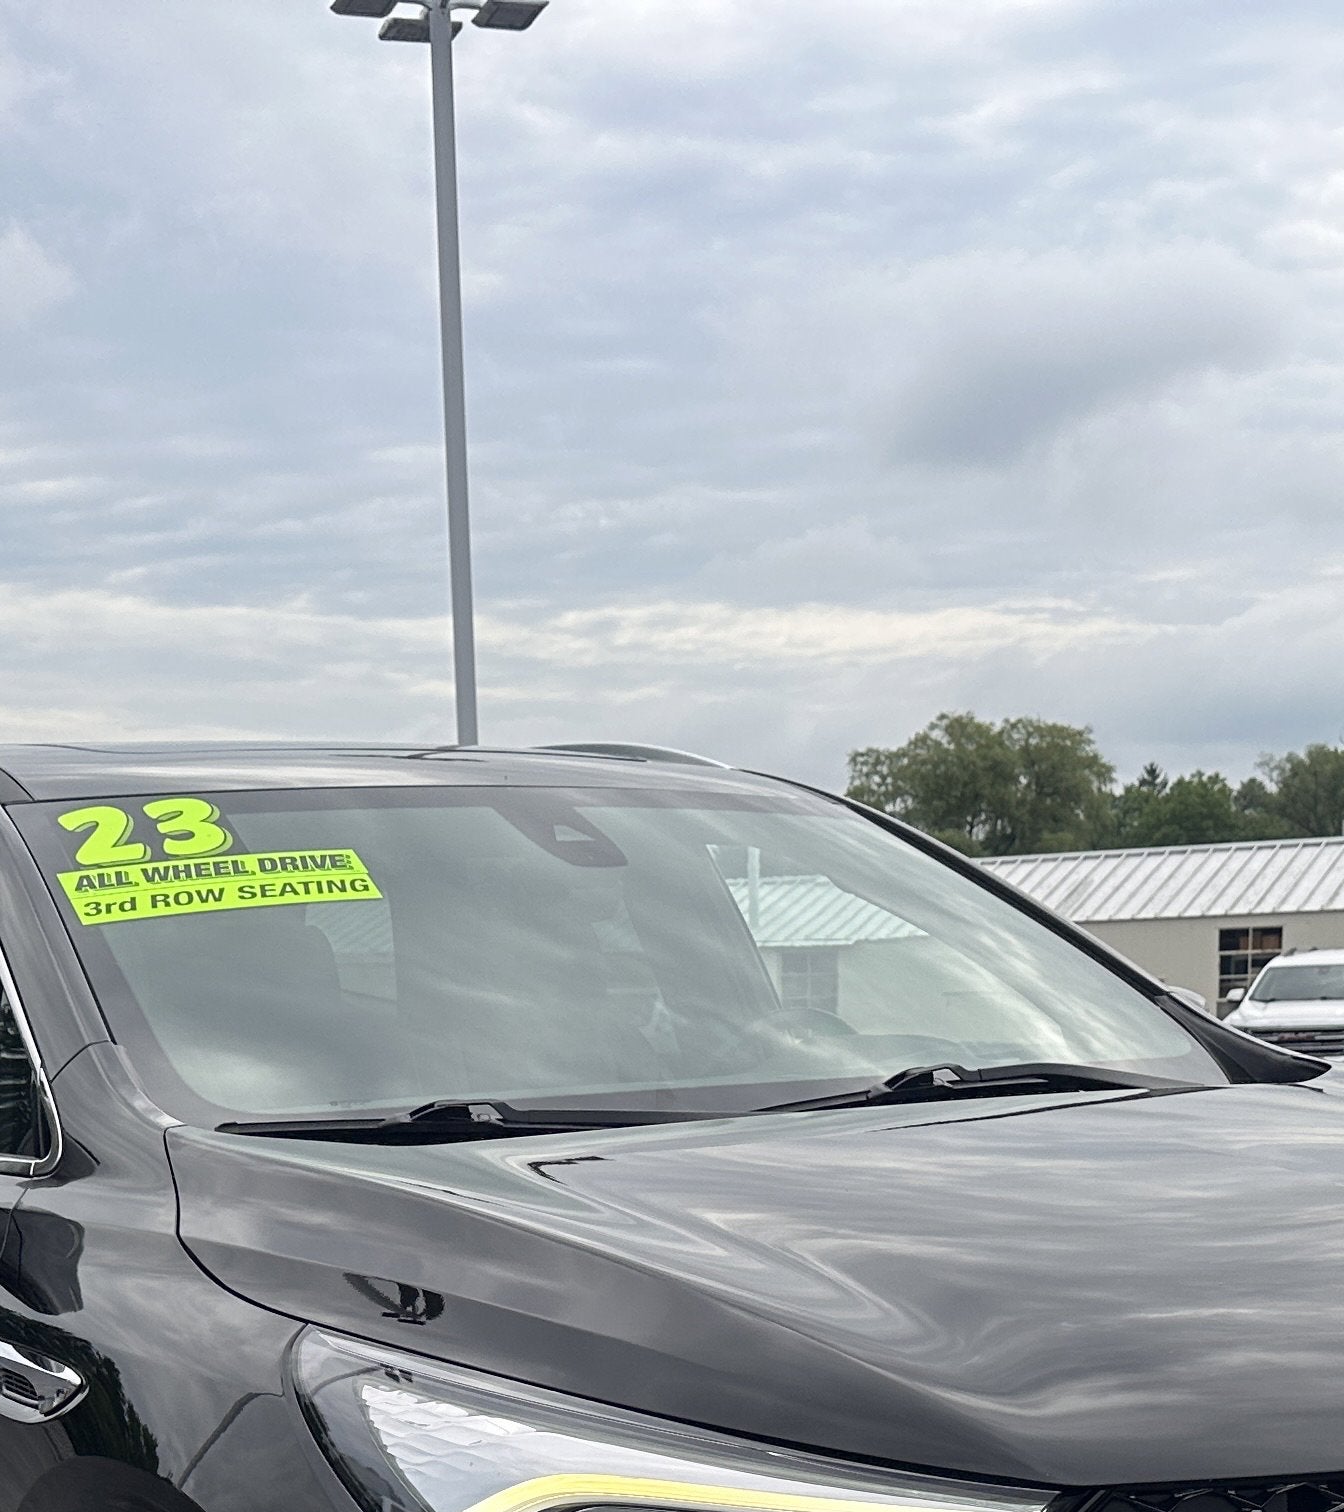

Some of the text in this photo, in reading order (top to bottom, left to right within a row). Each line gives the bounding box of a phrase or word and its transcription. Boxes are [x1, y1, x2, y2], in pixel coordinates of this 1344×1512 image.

[57, 798, 233, 867] 23
[75, 854, 355, 893] ALL WHEEL DRIVE
[83, 878, 371, 917] 3rd ROW SEATING
